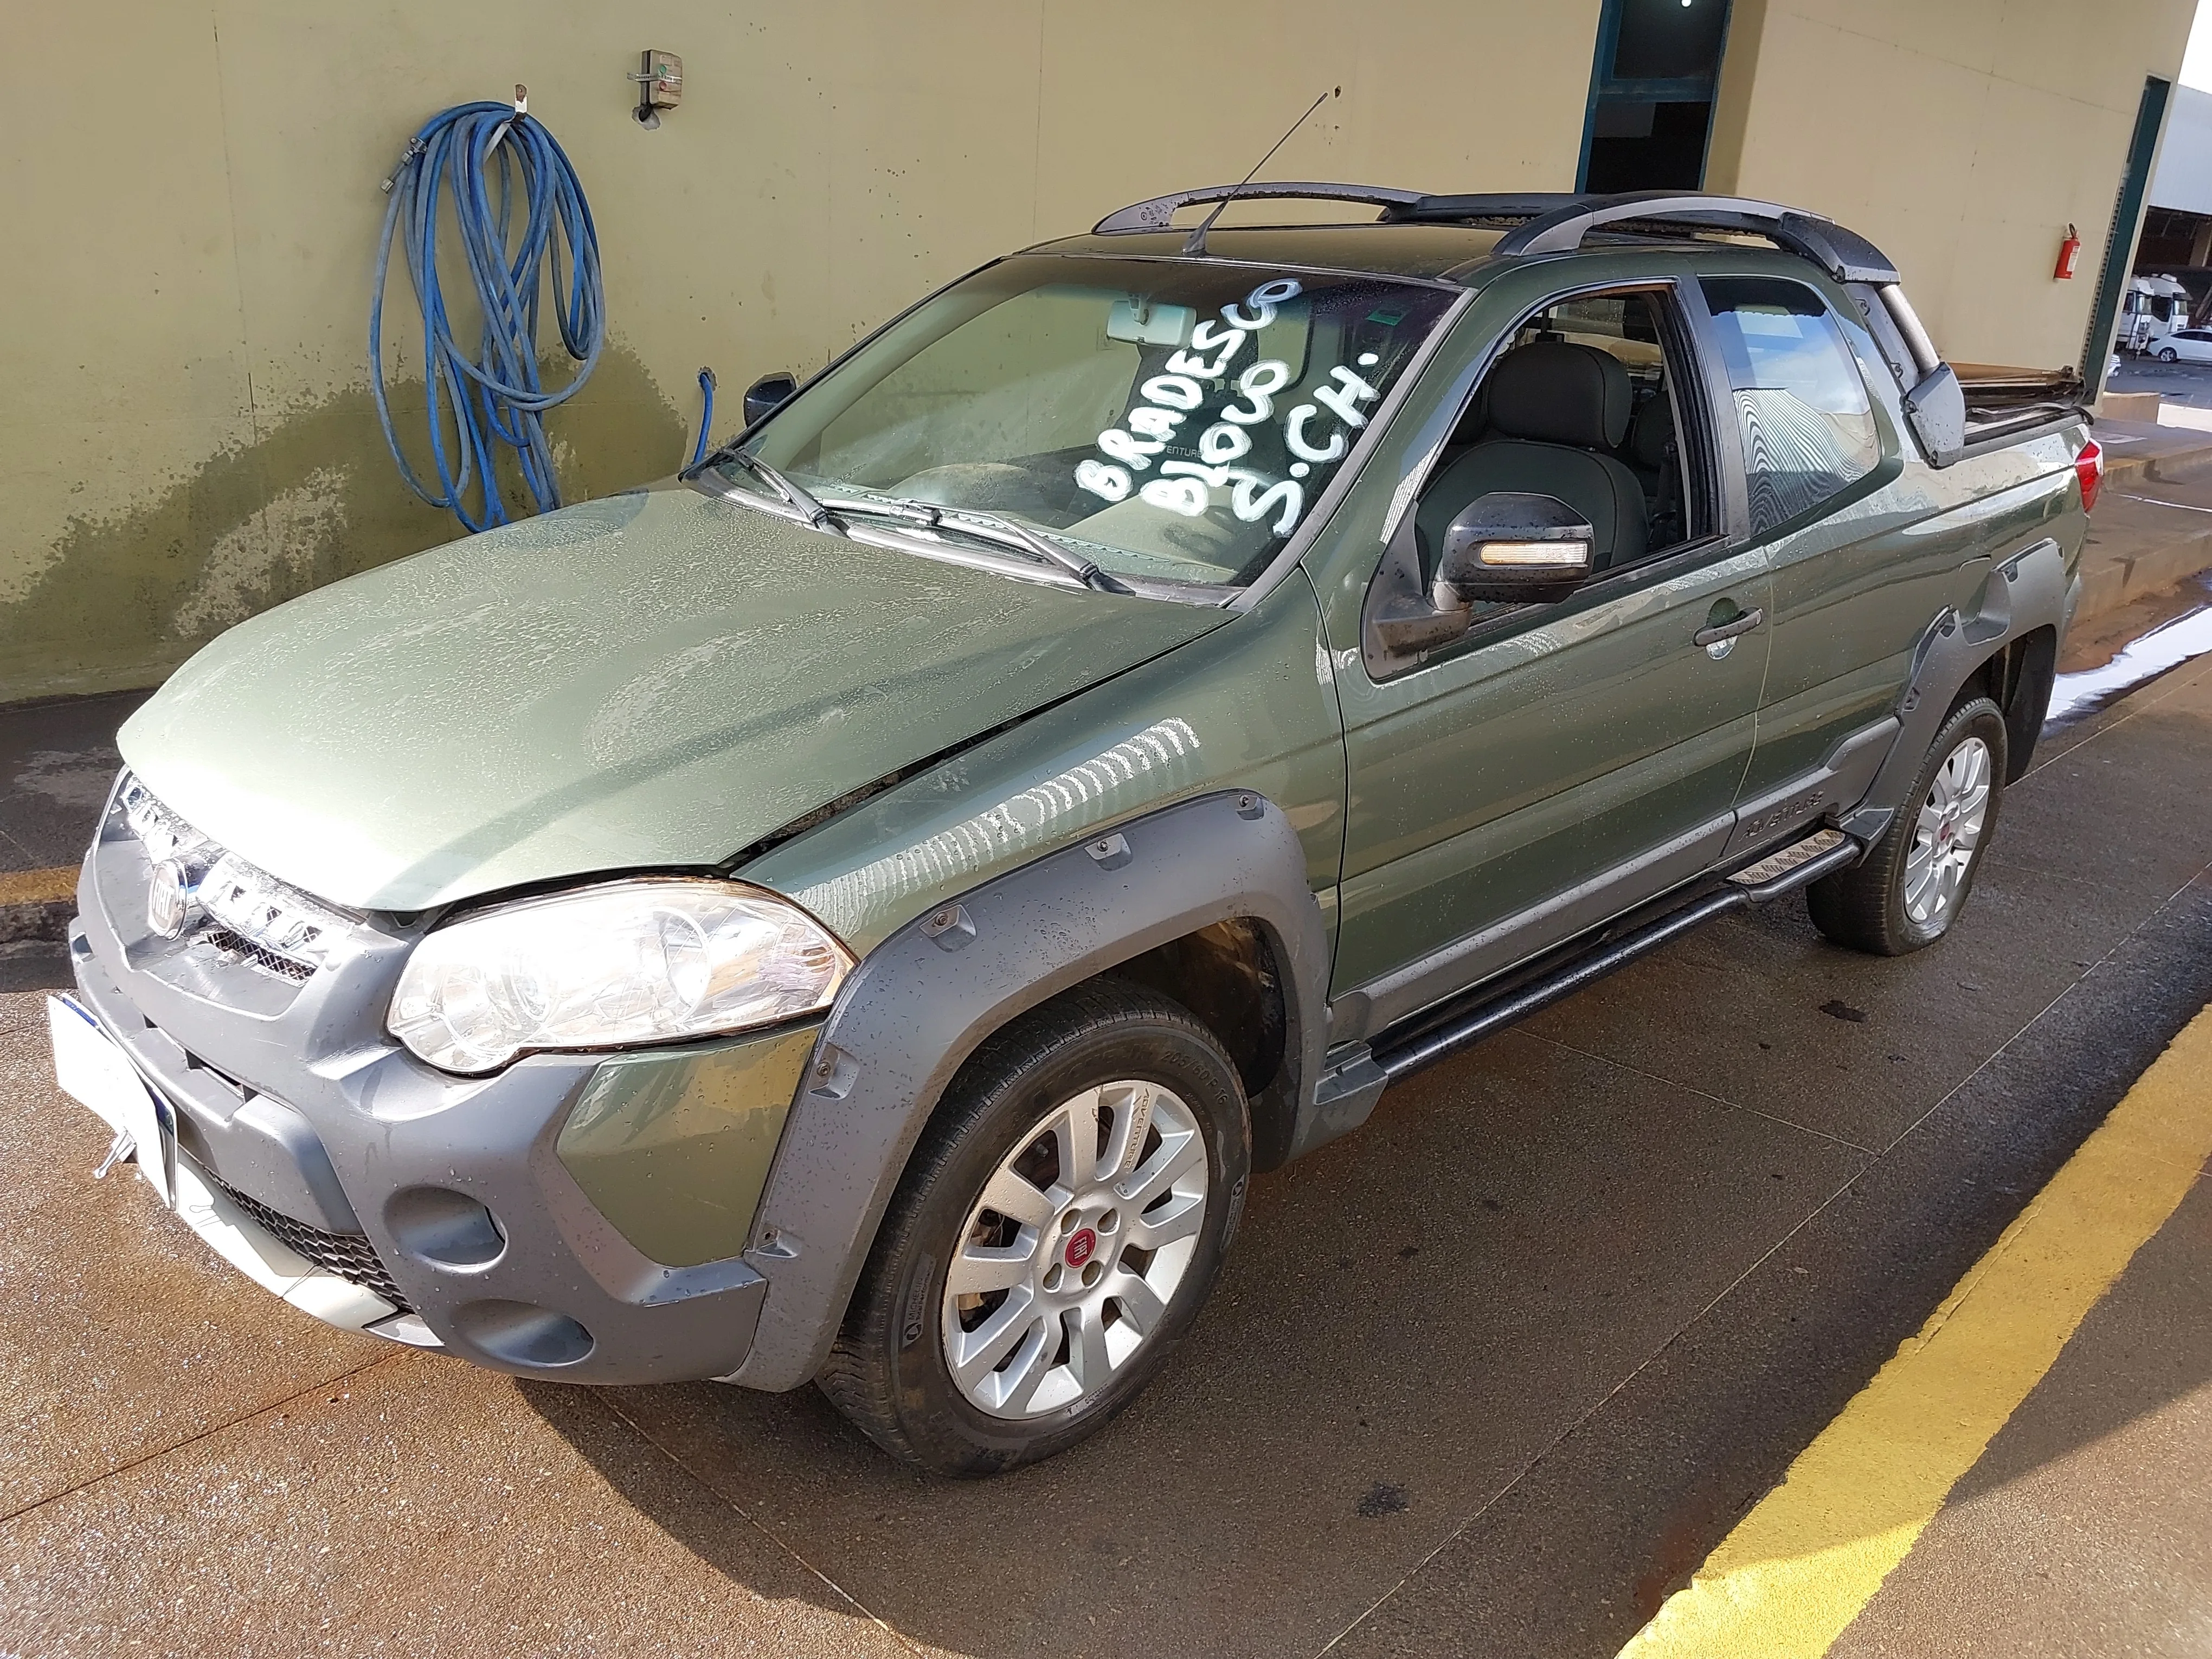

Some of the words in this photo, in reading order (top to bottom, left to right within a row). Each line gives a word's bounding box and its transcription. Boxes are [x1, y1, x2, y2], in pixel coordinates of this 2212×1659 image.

[1073, 277, 1303, 503] BRADESCO
[1166, 446, 1202, 458] ENTURE
[152, 878, 175, 920] FIAT
[1124, 1088, 1150, 1169] ADVENTURE
[1073, 1236, 1088, 1259] FIAT
[908, 1278, 923, 1321] MICHELIN
